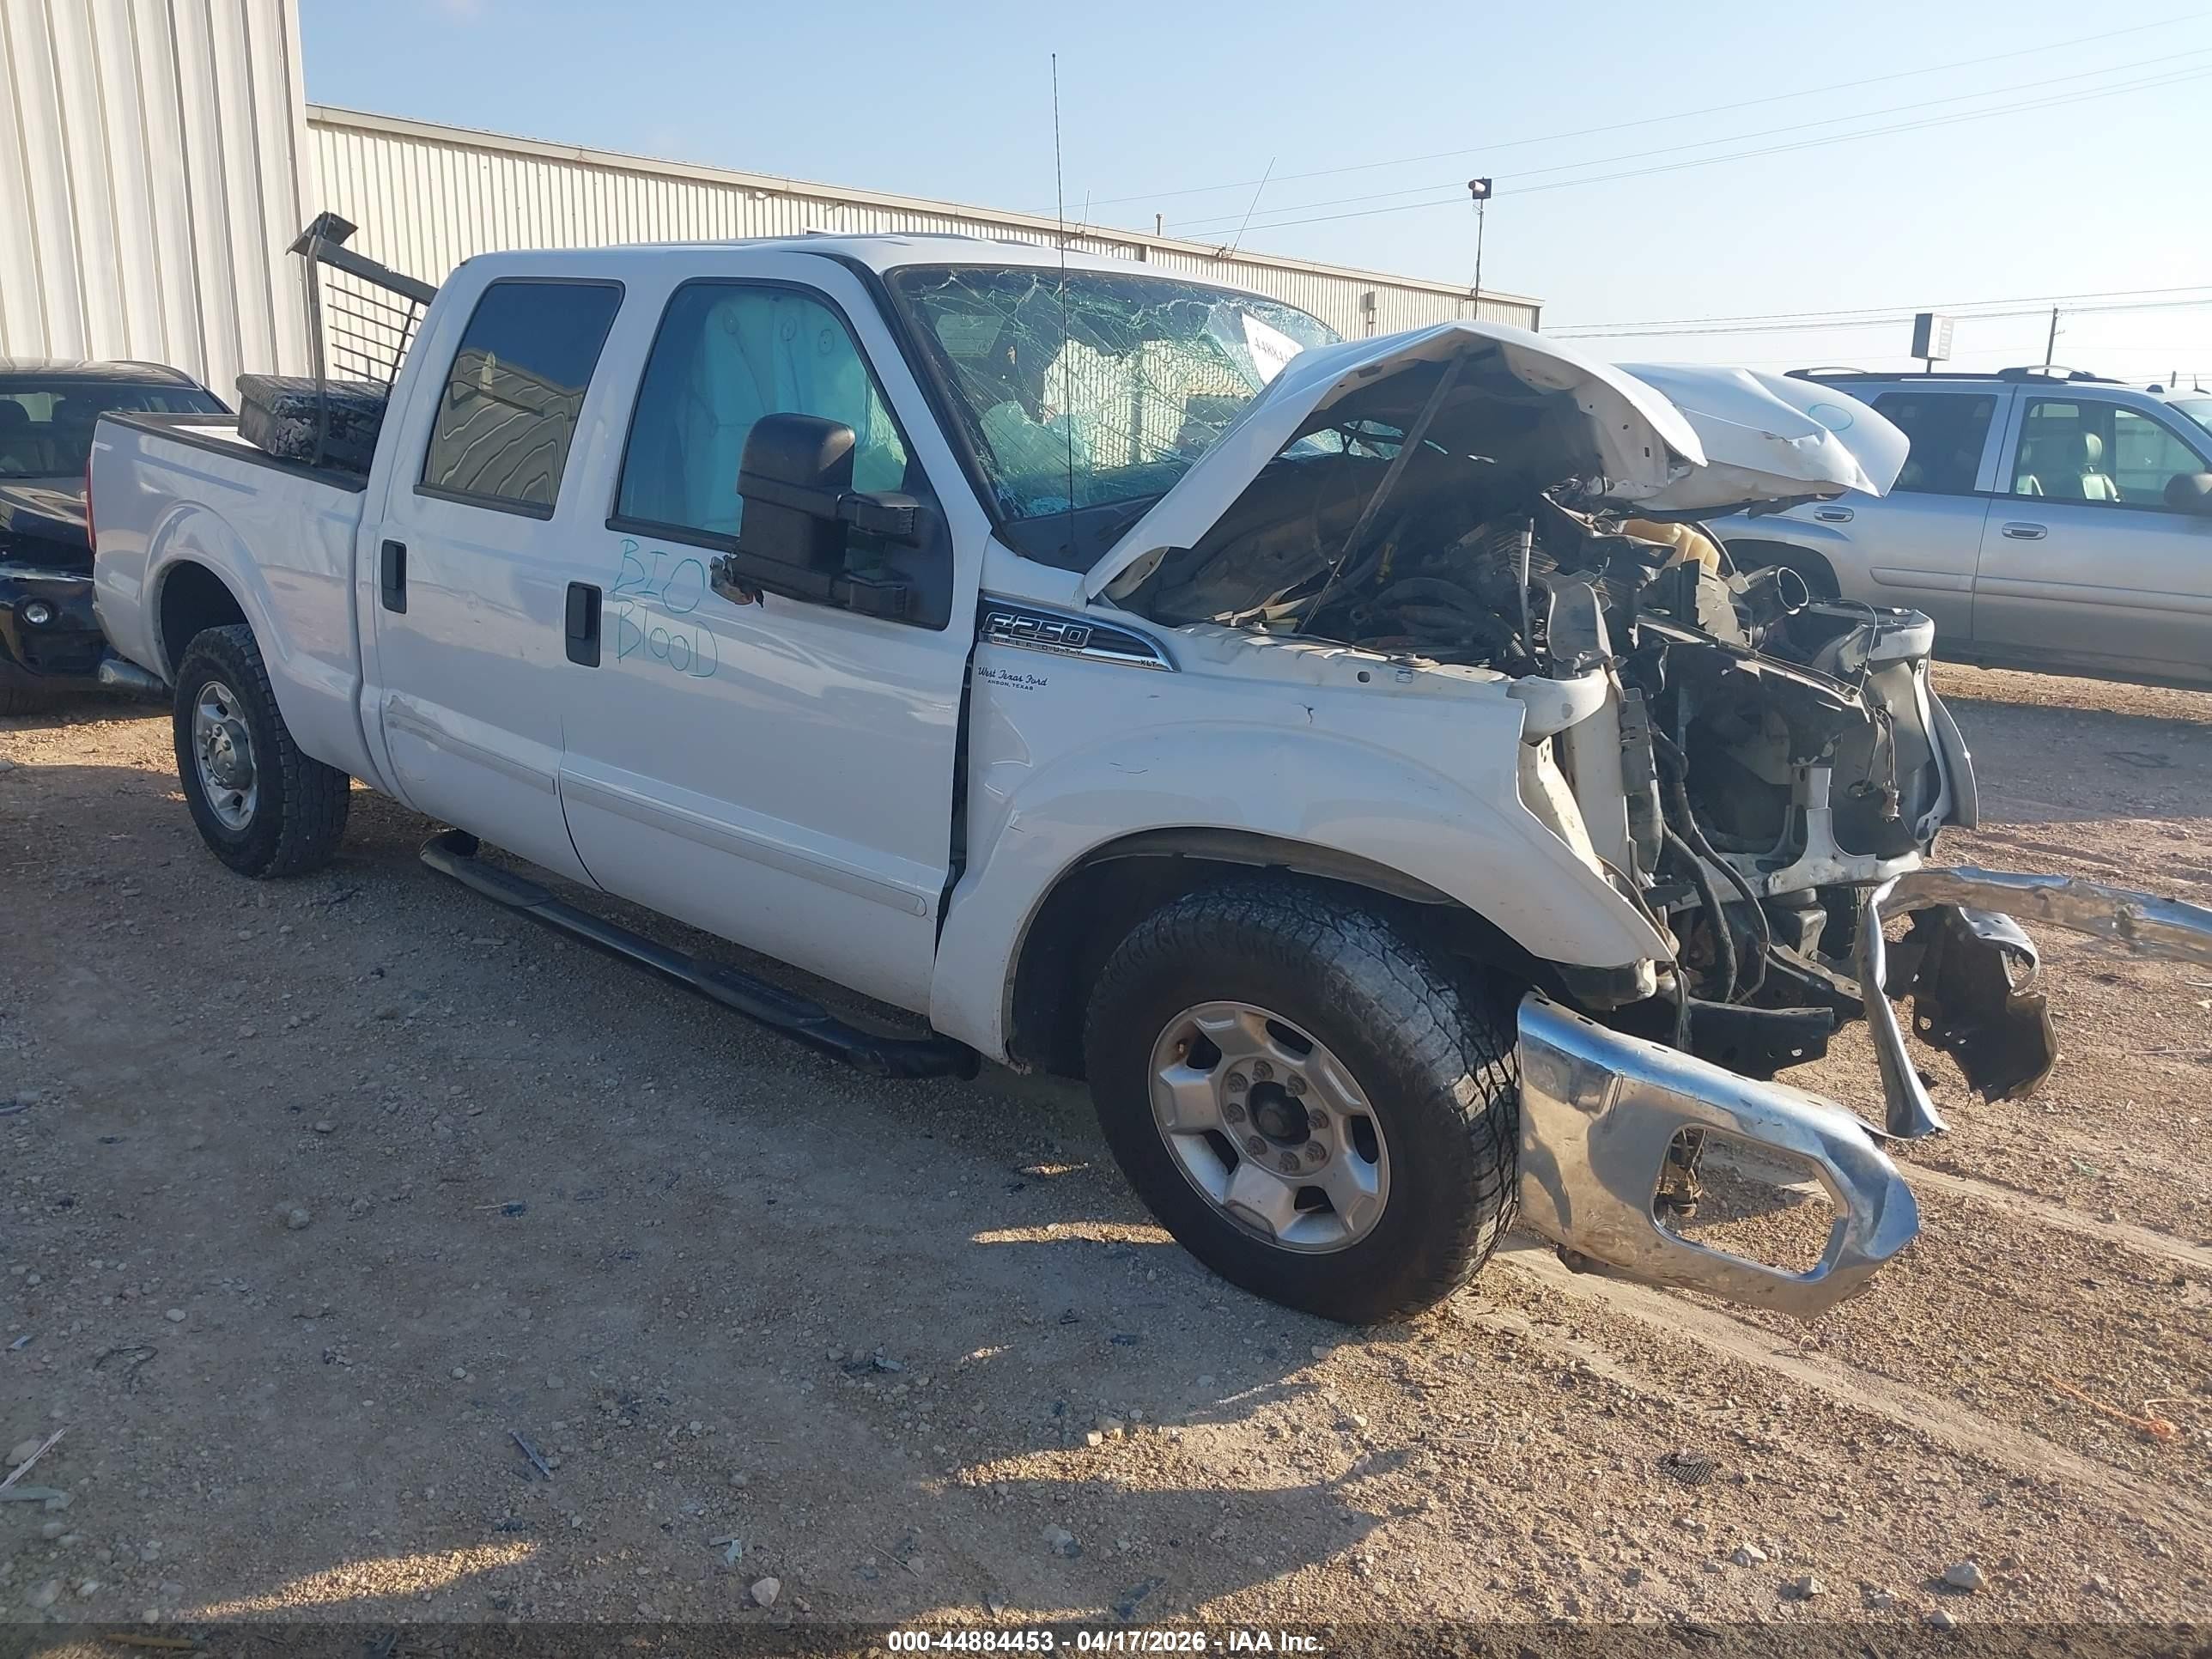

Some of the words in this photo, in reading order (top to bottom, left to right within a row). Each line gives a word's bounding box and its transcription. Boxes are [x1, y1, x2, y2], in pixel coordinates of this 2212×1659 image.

[609, 538, 706, 614] BIO
[978, 666, 996, 678] West
[998, 670, 1024, 682] Texas
[1026, 674, 1048, 686] Ford
